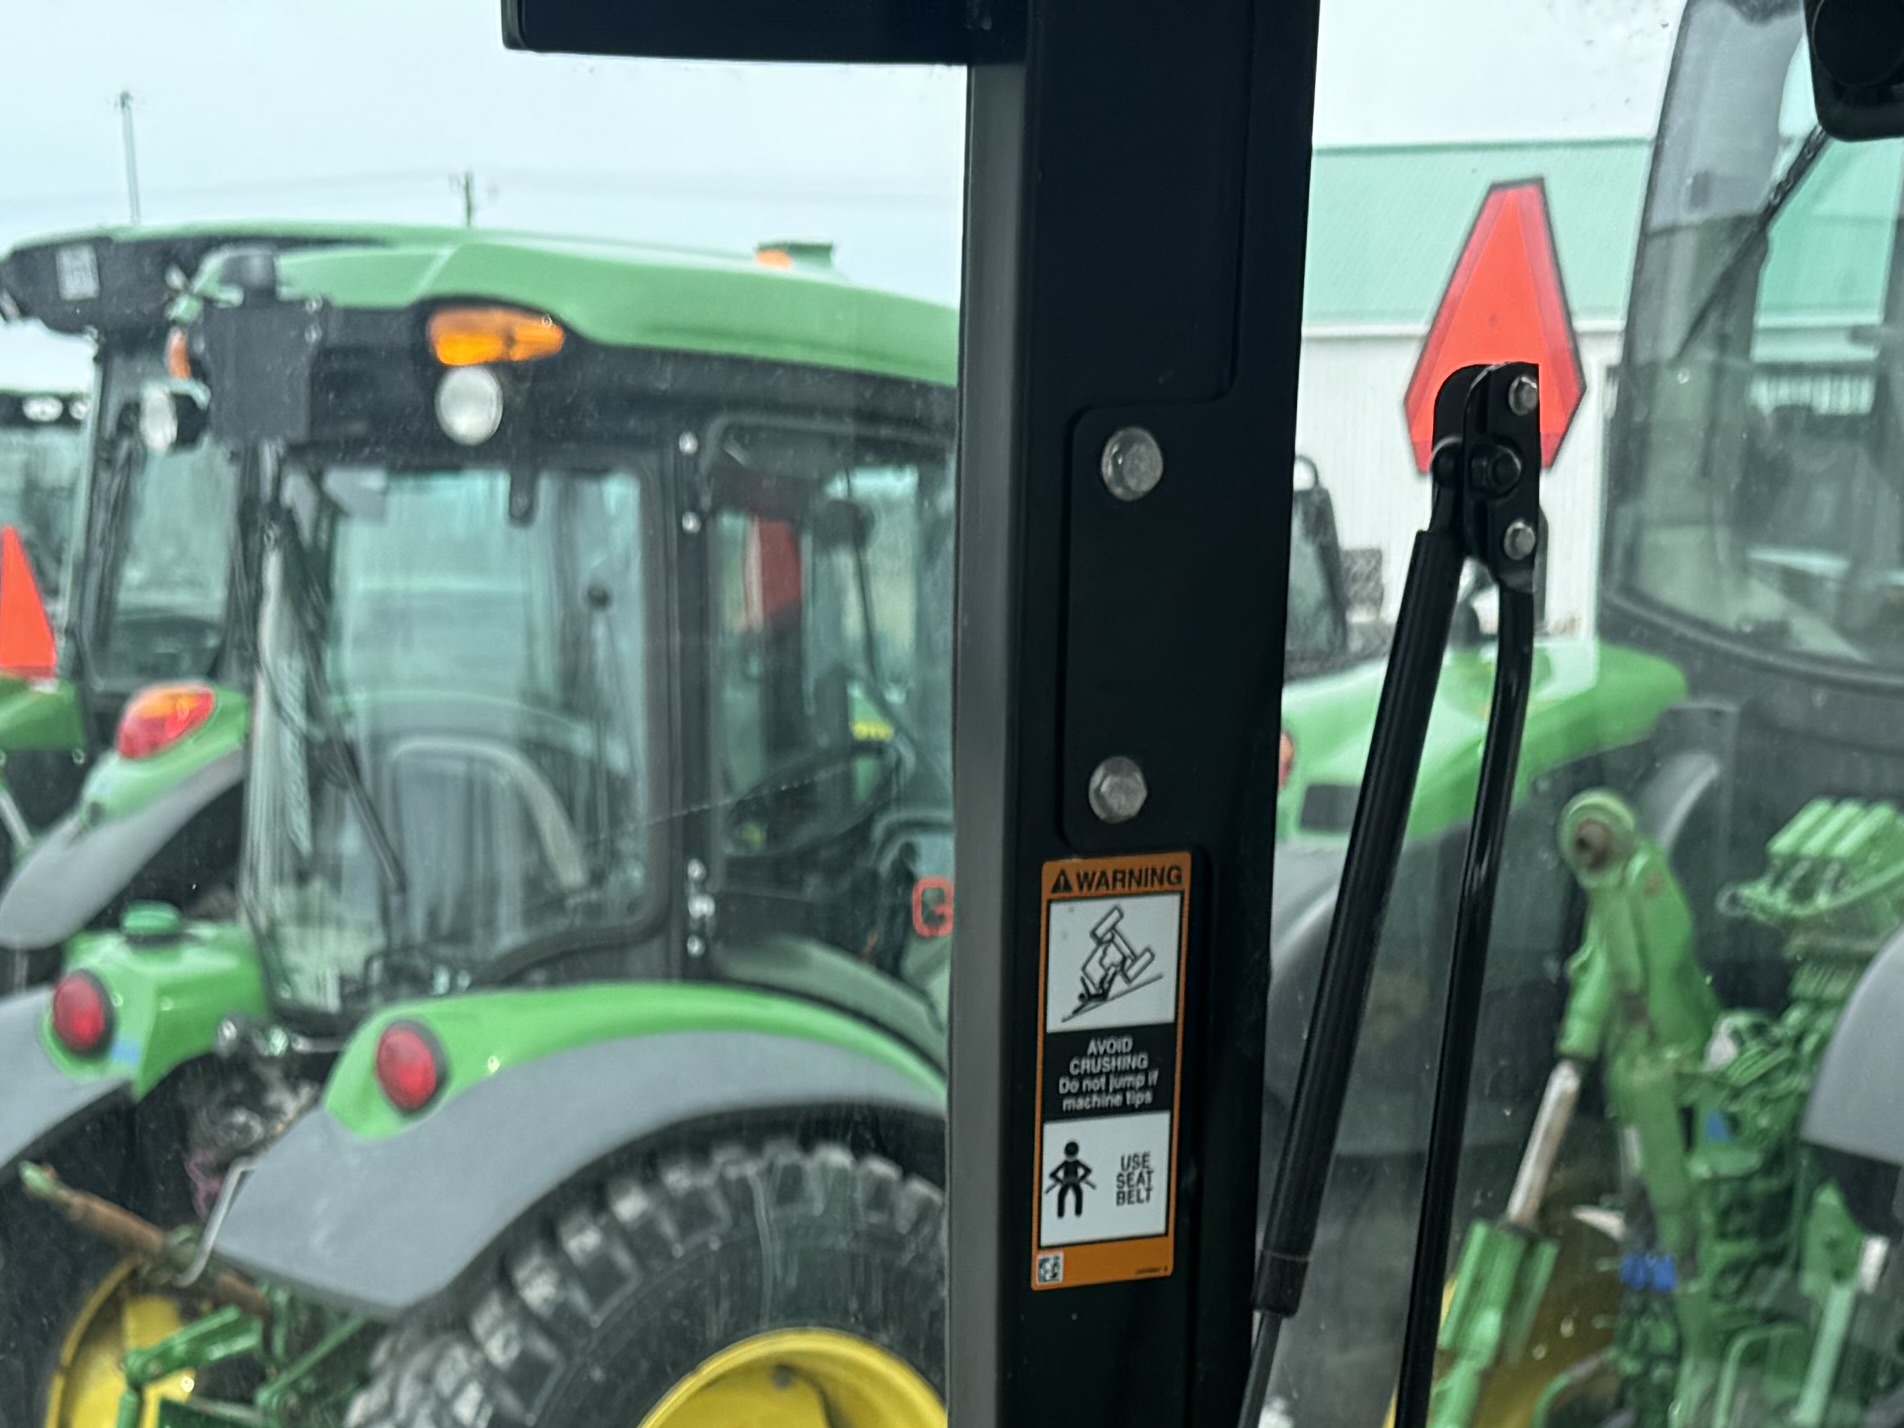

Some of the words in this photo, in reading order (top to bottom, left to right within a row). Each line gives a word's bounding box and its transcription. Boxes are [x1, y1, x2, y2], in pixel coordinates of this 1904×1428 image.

[1077, 866, 1183, 891] WARNING
[1087, 1035, 1133, 1056] AVOID
[1069, 1051, 1149, 1075] CRUSHING
[1059, 1076, 1080, 1094] Do
[1082, 1073, 1106, 1092] not
[1109, 1072, 1145, 1093] jump
[1148, 1068, 1159, 1086] if
[1063, 1091, 1123, 1111] machine
[1126, 1089, 1153, 1108] tips
[1121, 1149, 1151, 1171] USE
[1116, 1167, 1154, 1189] SEAT
[1116, 1181, 1153, 1206] BELT
